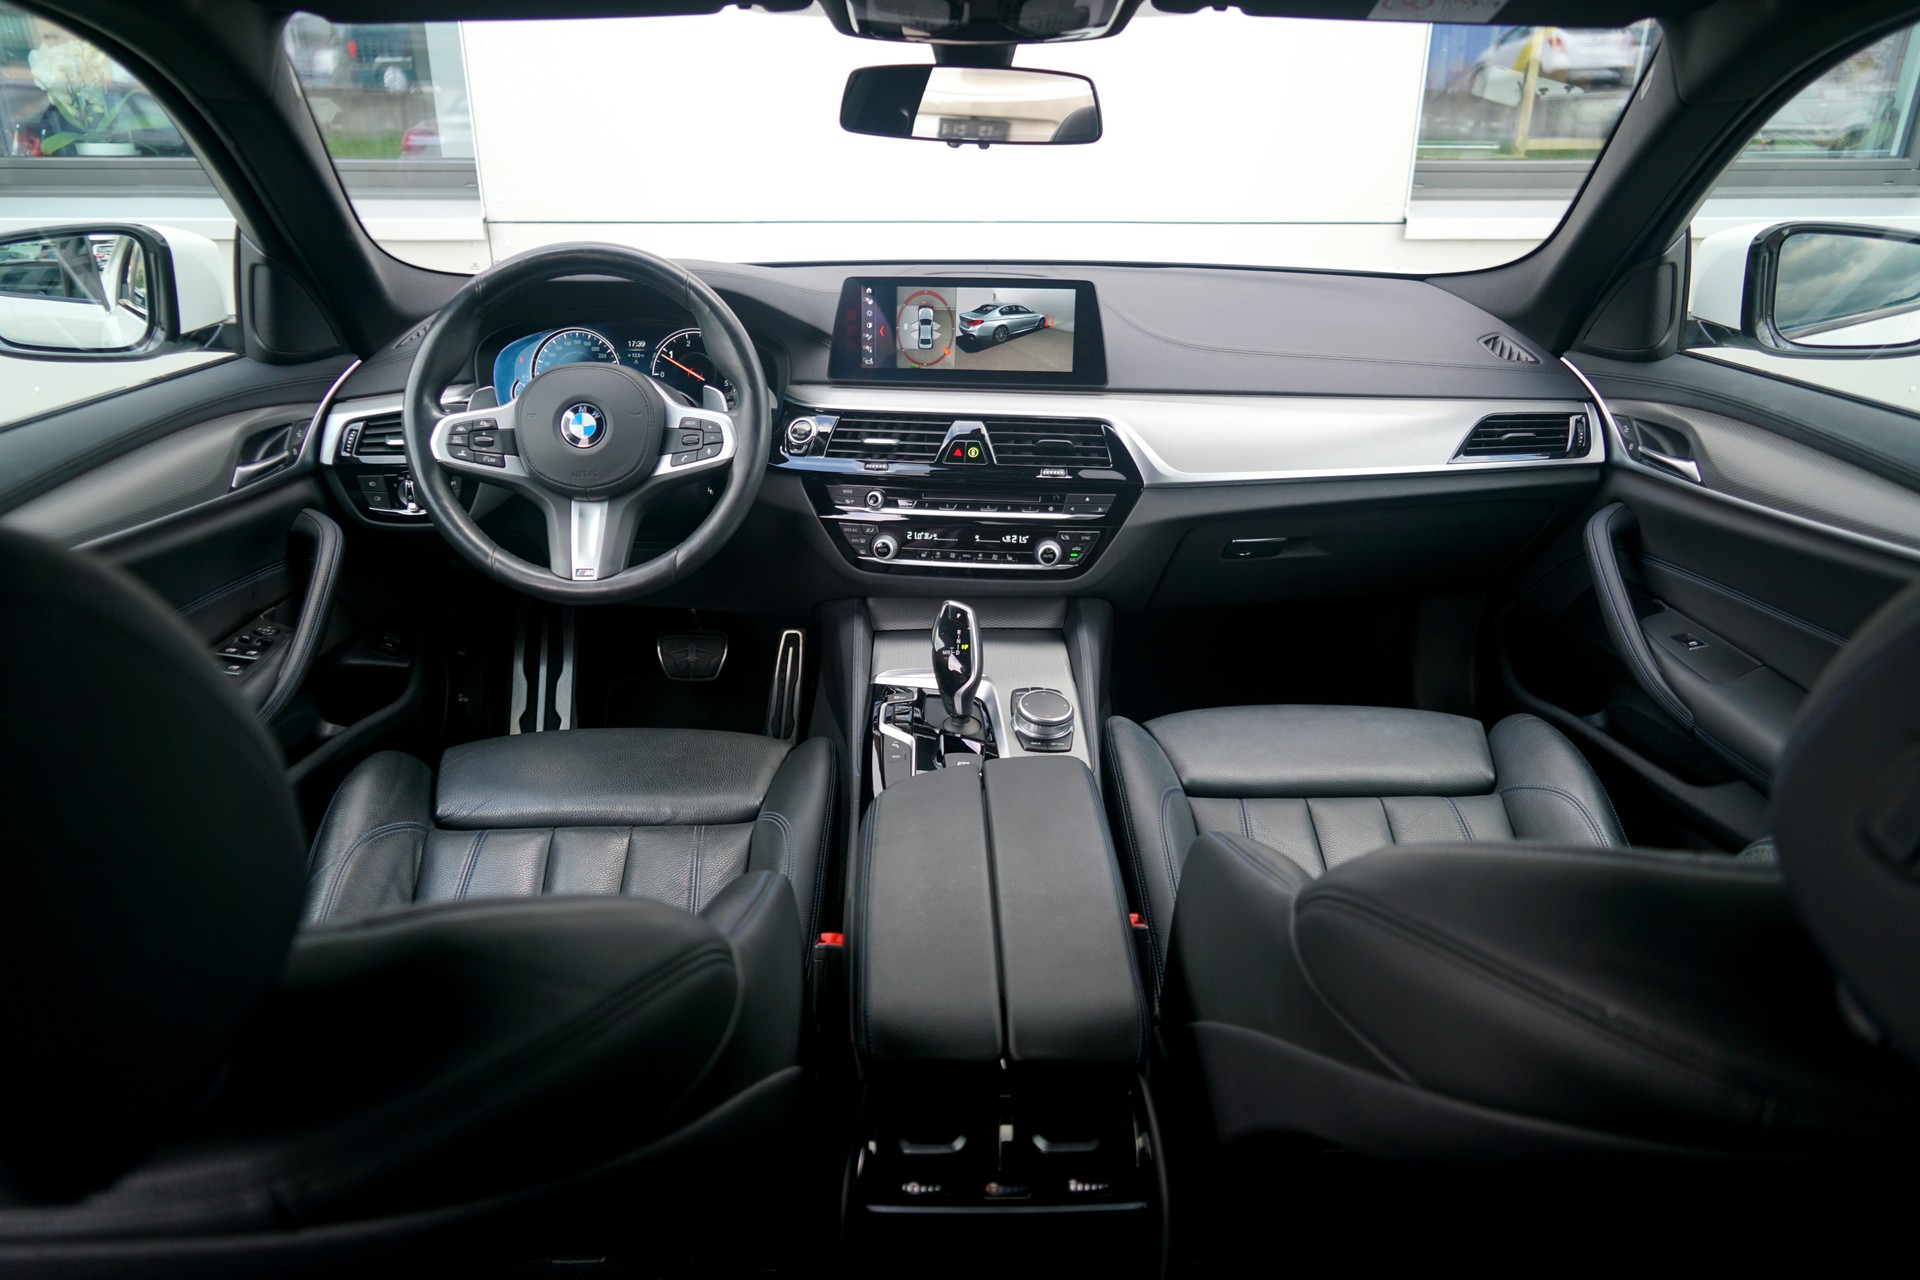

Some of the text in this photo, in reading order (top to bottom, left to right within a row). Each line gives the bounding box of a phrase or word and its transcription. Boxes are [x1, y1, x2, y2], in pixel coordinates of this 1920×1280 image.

[627, 340, 646, 348] 17:39
[668, 350, 674, 359] 1
[570, 470, 598, 478] AIRBAG
